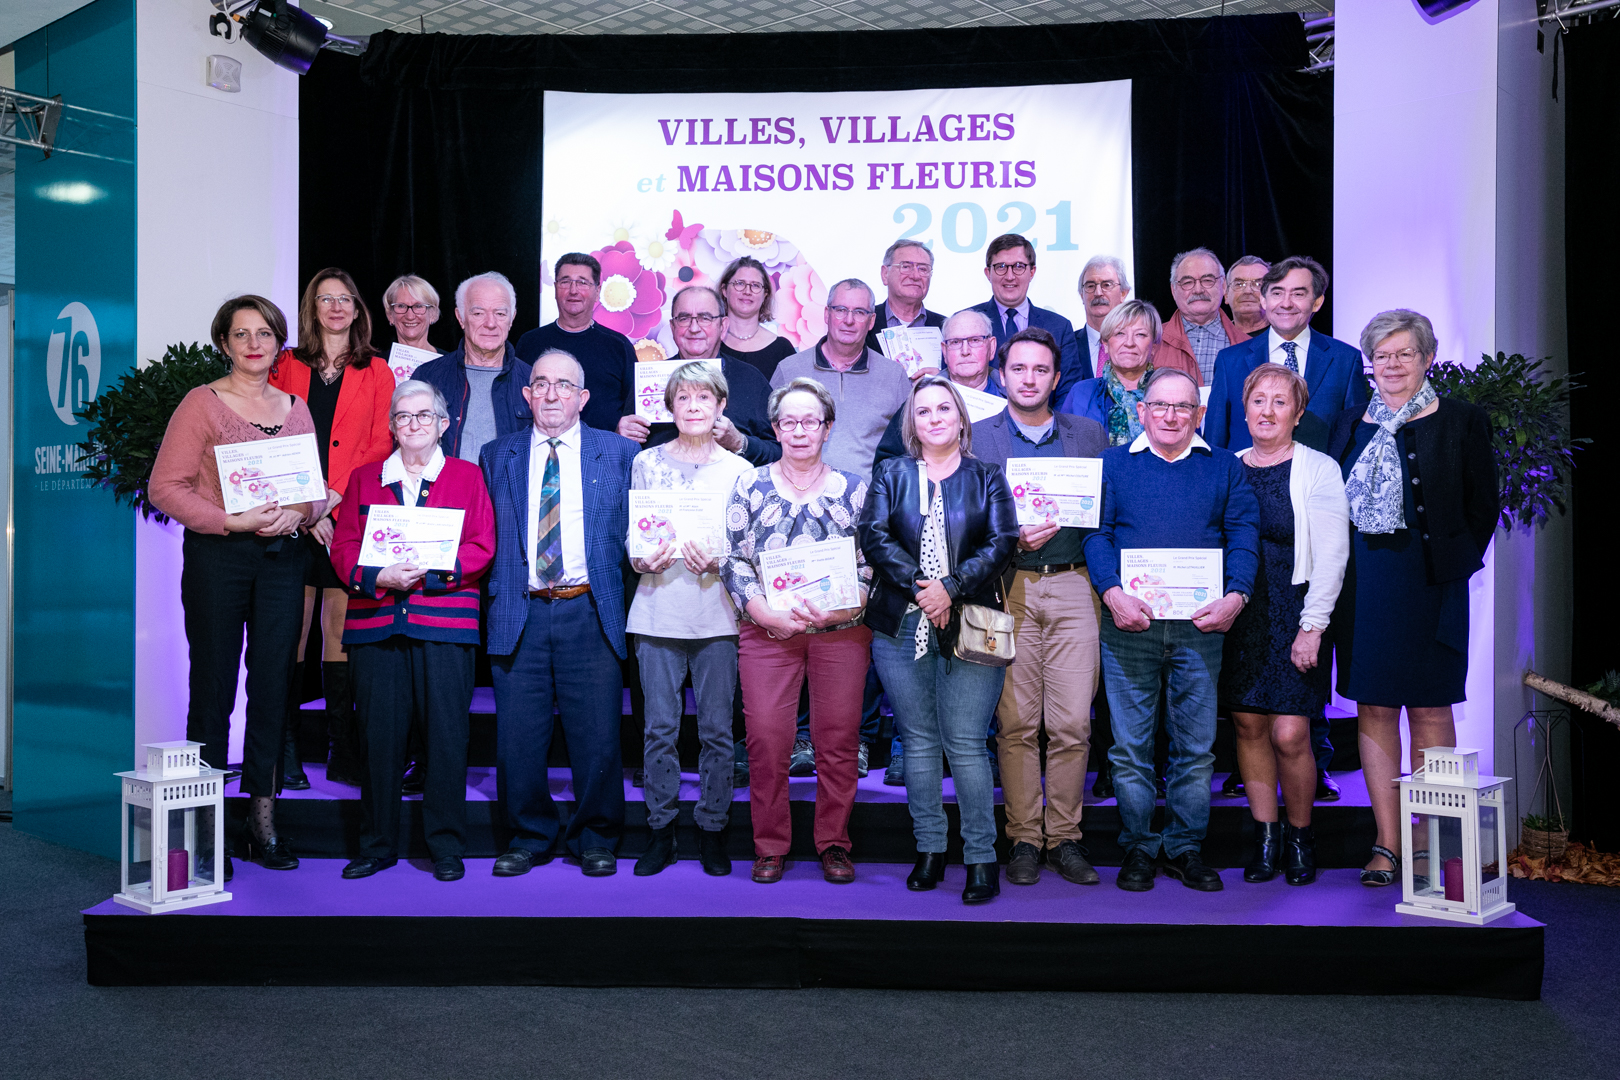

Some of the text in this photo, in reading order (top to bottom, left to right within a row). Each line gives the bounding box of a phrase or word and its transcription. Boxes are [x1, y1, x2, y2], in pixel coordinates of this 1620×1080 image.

[657, 112, 1016, 149] VILLES, VILLAGES
[636, 160, 1037, 193] et MAISONS FLEURIS
[892, 200, 1079, 254] 2021
[52, 316, 90, 421] 76
[40, 481, 49, 491] LE
